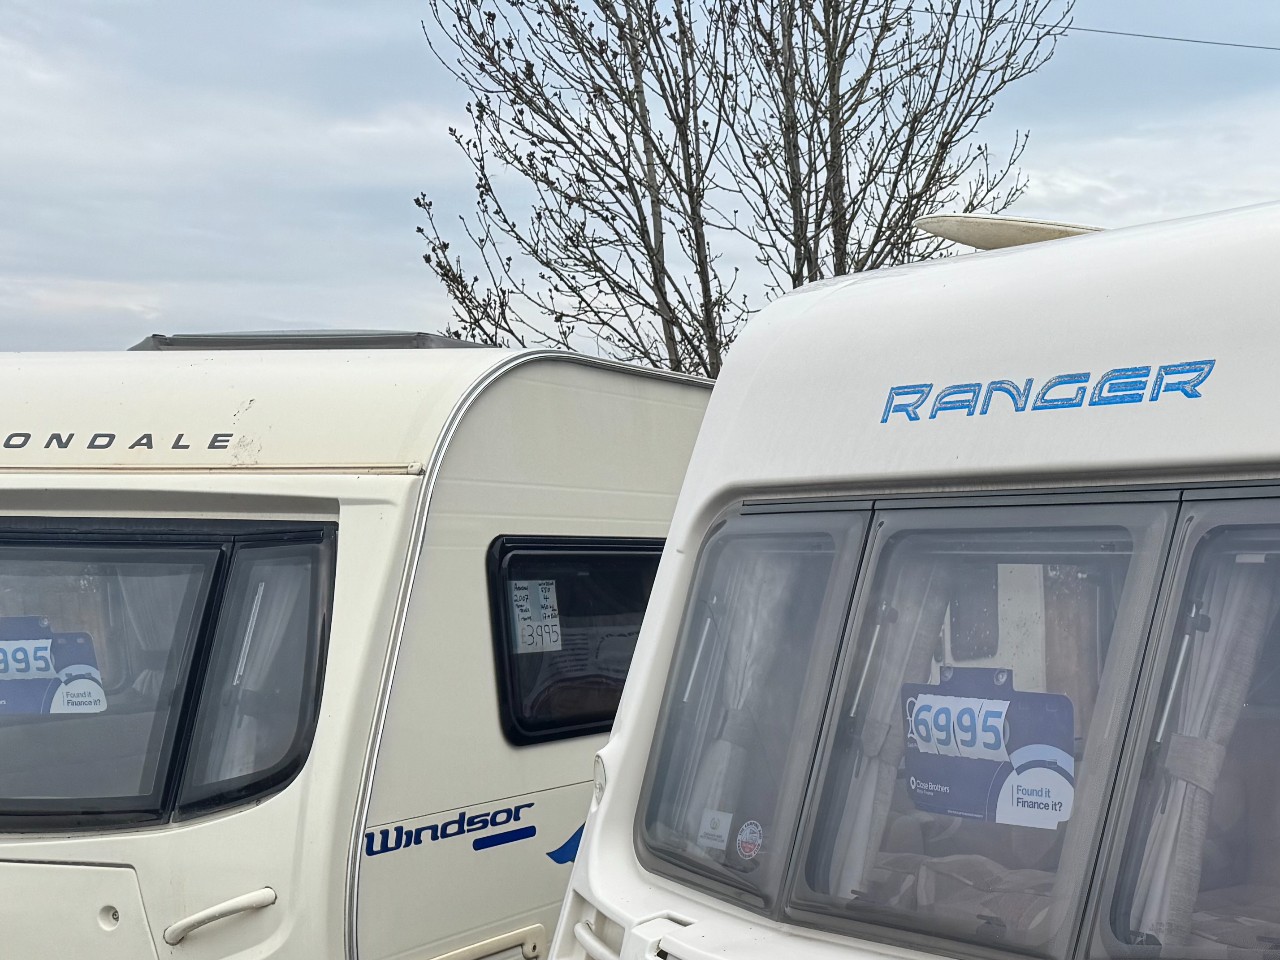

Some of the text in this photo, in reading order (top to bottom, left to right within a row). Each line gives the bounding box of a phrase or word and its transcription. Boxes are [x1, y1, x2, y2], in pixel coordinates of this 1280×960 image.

[880, 359, 1216, 423] RANGER
[3, 433, 233, 449] ONDALE
[916, 780, 928, 790] Close
[928, 782, 950, 793] Brothers
[1016, 785, 1051, 798] Found it
[1016, 798, 1063, 812] Finance it?
[365, 802, 535, 856] Windsor
